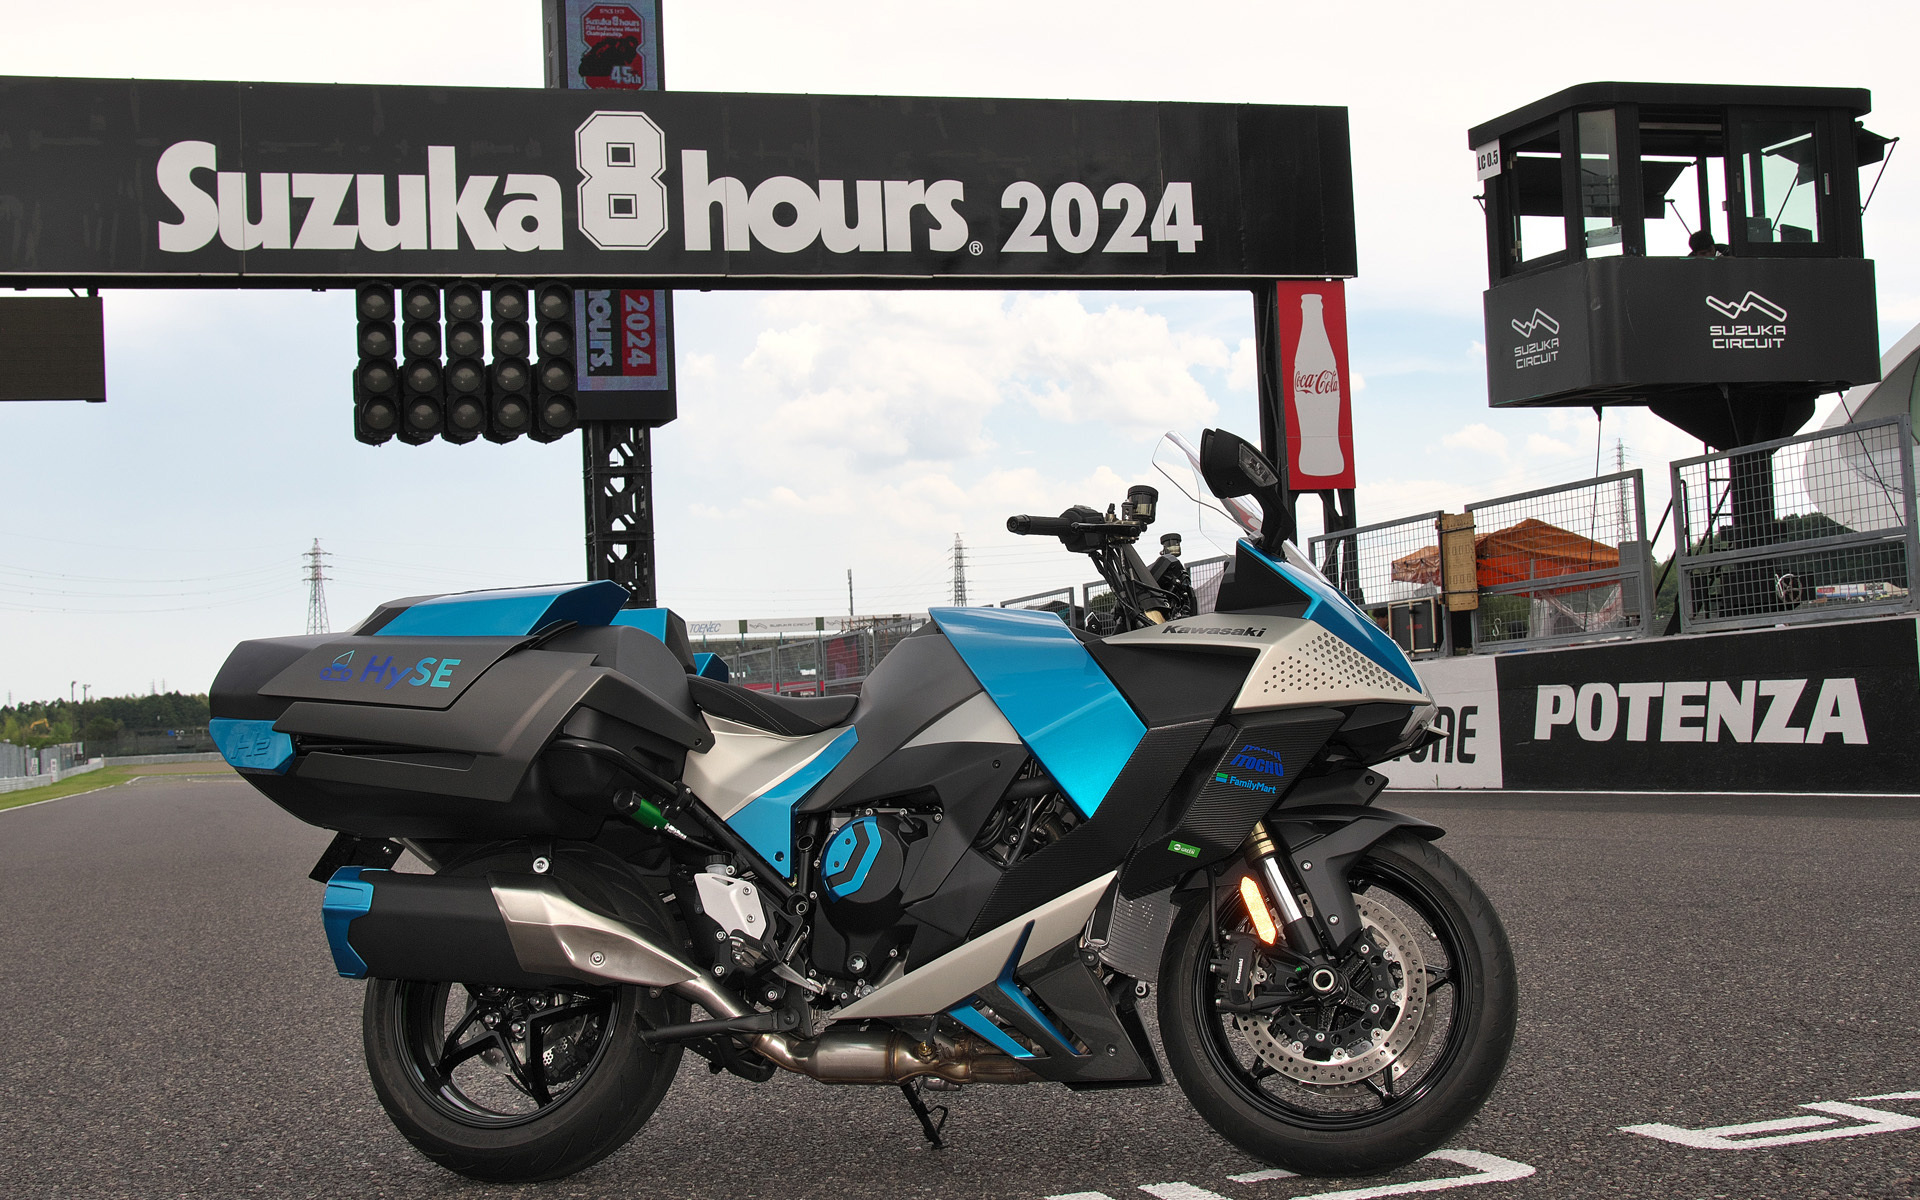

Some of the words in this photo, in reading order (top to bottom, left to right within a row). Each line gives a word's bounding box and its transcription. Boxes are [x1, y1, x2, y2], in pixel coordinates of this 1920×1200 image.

[611, 65, 642, 84] 45th
[1487, 149, 1499, 167] 0.5
[157, 141, 563, 252] Suzuka
[575, 111, 669, 251] 8
[1001, 181, 1204, 254] 2024
[625, 294, 652, 368] 2024
[1710, 325, 1787, 336] SUZUKA
[1514, 337, 1560, 357] SUZUKA
[1712, 338, 1785, 349] CIRCUIT
[1515, 350, 1559, 369] CIRCUIT
[1295, 369, 1339, 395] Coca-Cola
[689, 621, 722, 634] TOENEC
[1162, 624, 1267, 638] Kawasaki
[359, 655, 461, 690] HySE
[1534, 678, 1869, 745] POTENZA
[1230, 753, 1284, 777] ITOCHU
[1229, 775, 1277, 795] FamilyMart
[1235, 958, 1244, 984] Kawasaki
